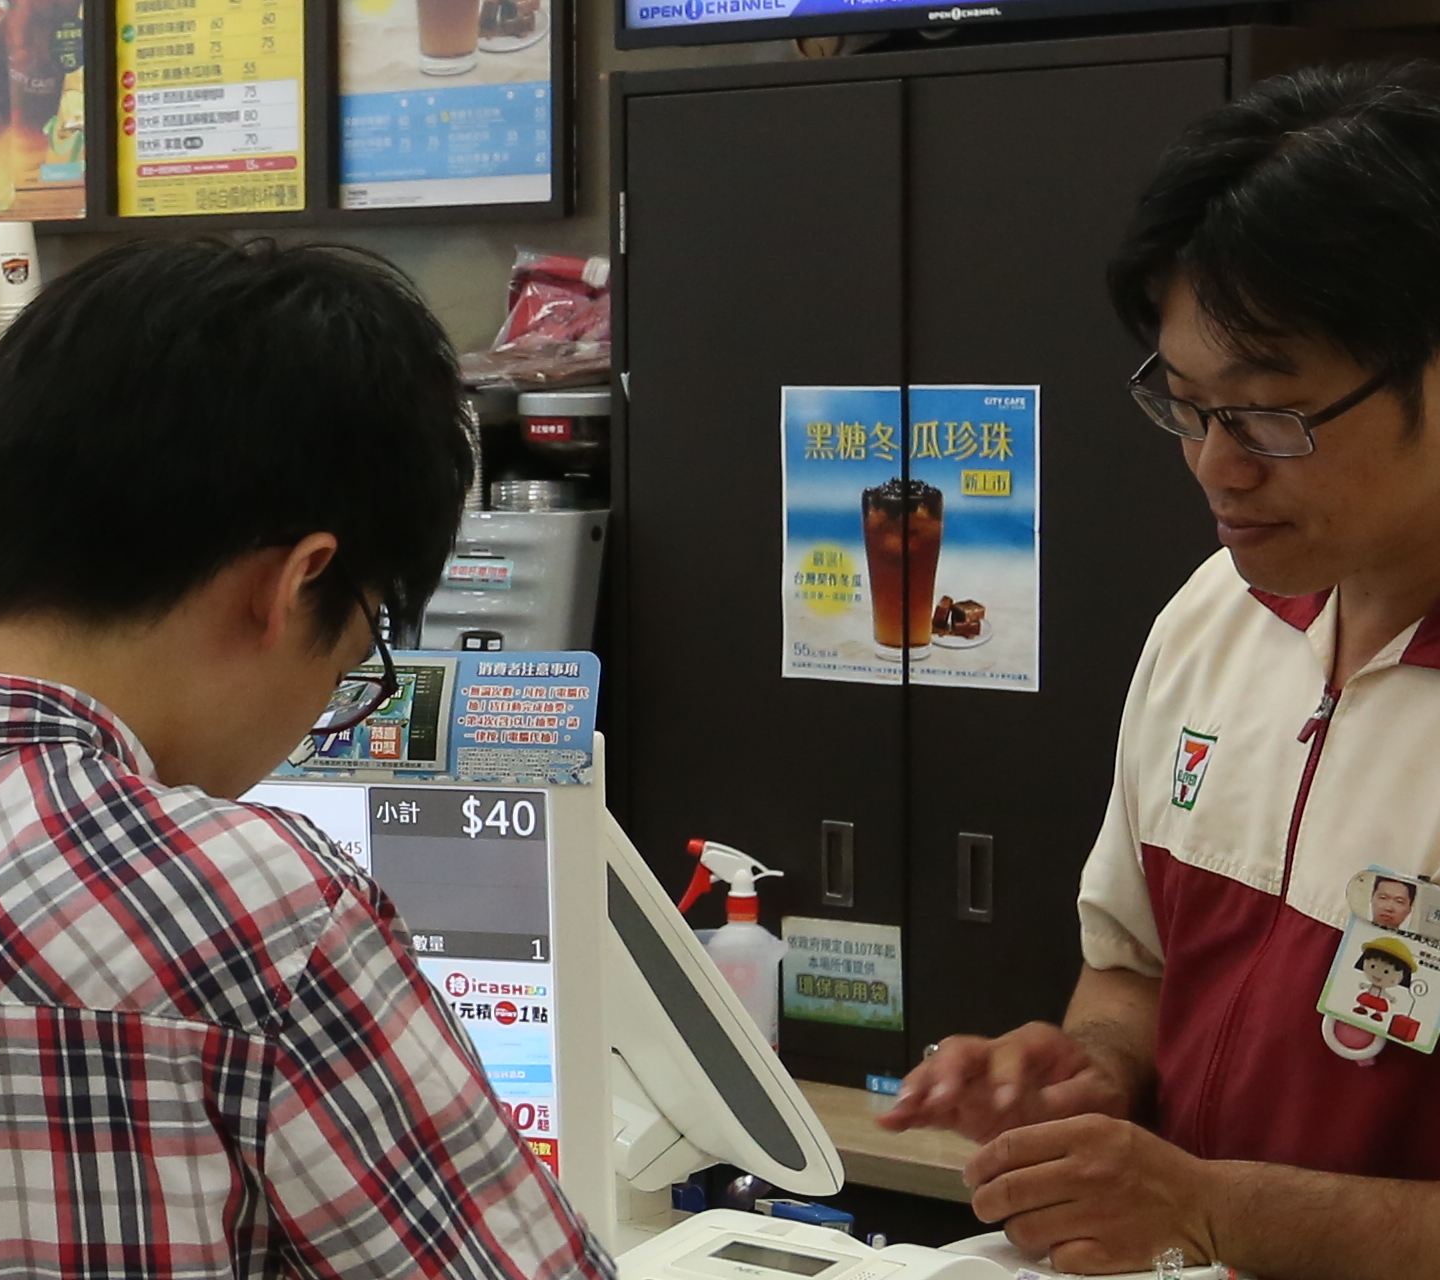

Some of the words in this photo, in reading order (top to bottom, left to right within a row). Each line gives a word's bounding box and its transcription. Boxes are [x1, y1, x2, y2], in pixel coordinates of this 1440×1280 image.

[984, 397, 1002, 406] CITY
[1004, 397, 1026, 406] CAFE
[804, 420, 1013, 461] 黑糖冬瓜珍珠
[964, 472, 1009, 494] 新上市
[477, 661, 580, 678] 消費者注意事項
[376, 800, 420, 824] 小計
[461, 795, 536, 838] $40
[412, 934, 446, 954] 數量
[531, 938, 546, 960] 1
[787, 934, 896, 959] 依政府規定自107年起
[808, 956, 875, 975] 本場所僅提供
[797, 974, 889, 1005] 環保兩用袋
[520, 1004, 549, 1024] 1點
